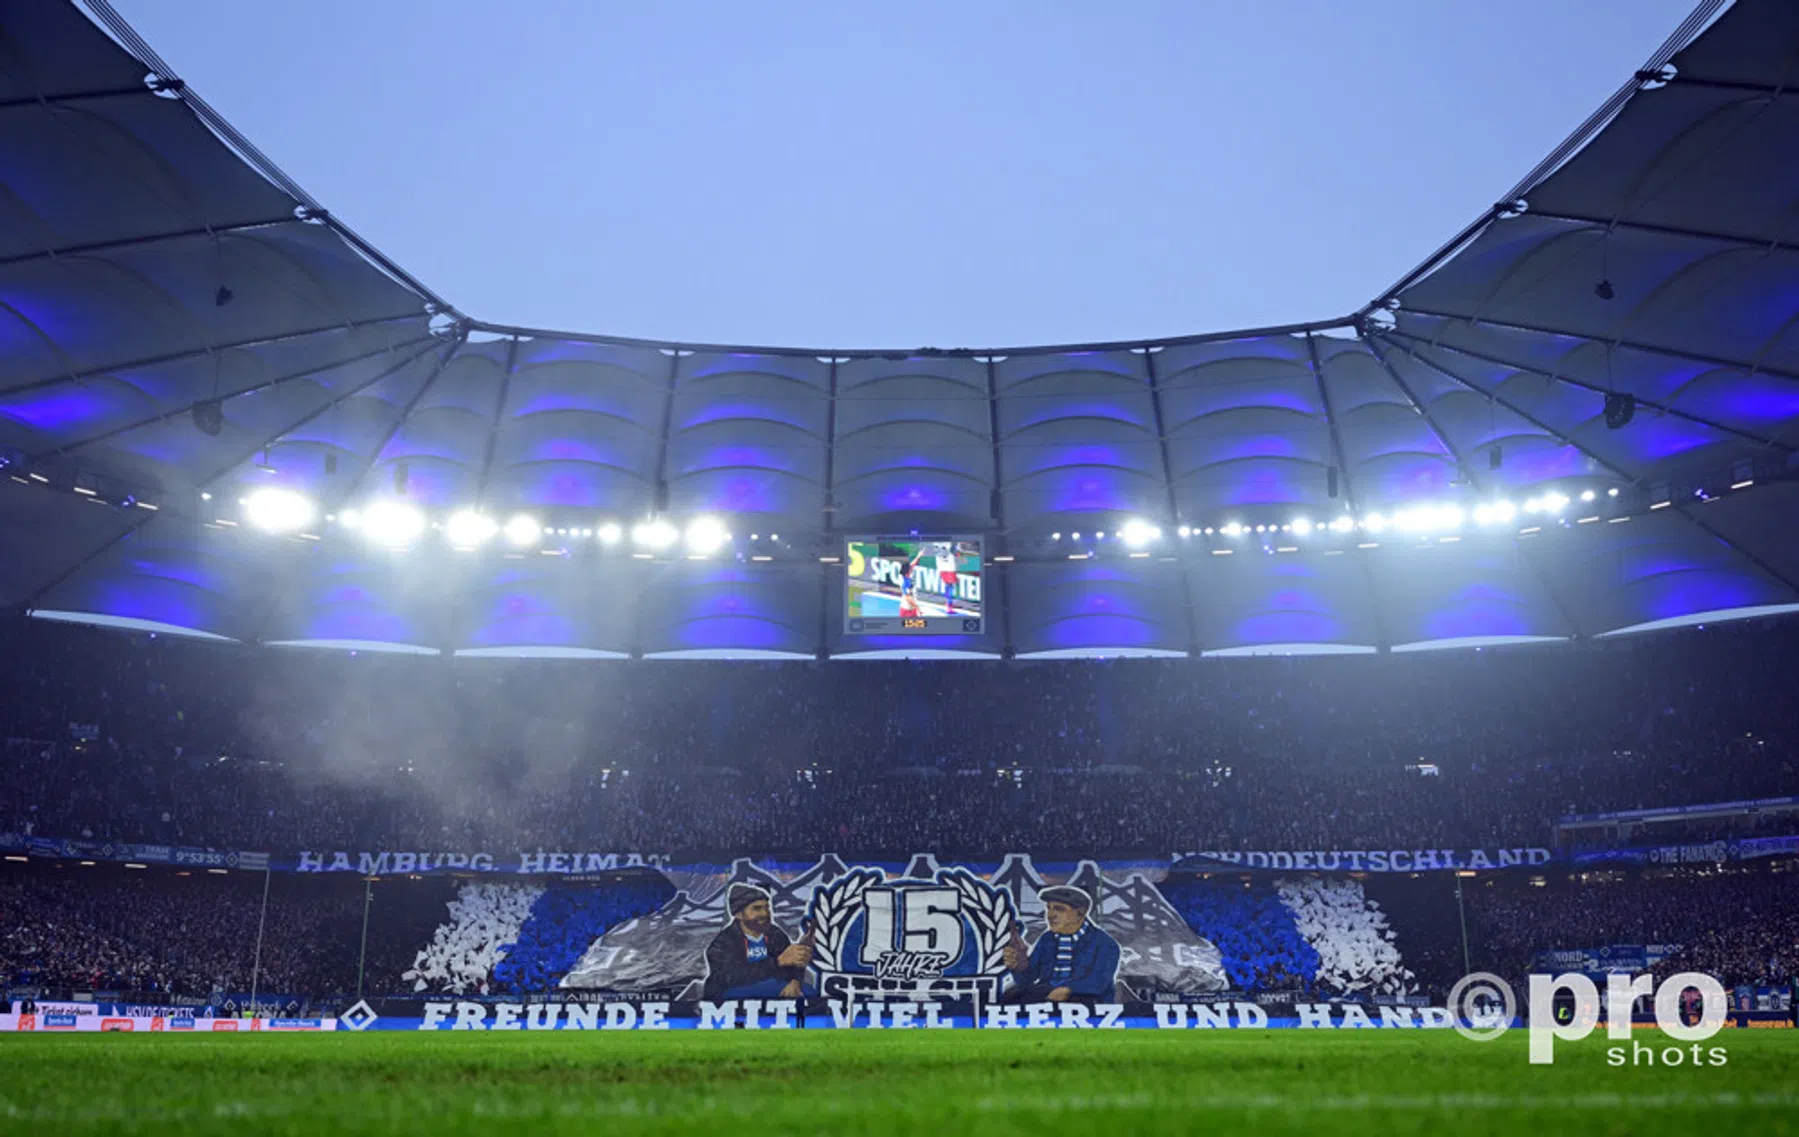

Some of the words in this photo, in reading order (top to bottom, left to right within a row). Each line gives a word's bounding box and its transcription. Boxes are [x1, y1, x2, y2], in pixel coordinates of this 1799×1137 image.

[1171, 848, 1551, 872] RDDEUTSCHLAND
[860, 886, 964, 966] 15
[876, 952, 947, 980] JAHRE
[419, 1000, 670, 1030] FREUNDE
[697, 999, 797, 1029] MIT
[827, 1000, 954, 1029] VIEL
[984, 1002, 1126, 1029] HERZ
[1153, 1001, 1268, 1029] UND
